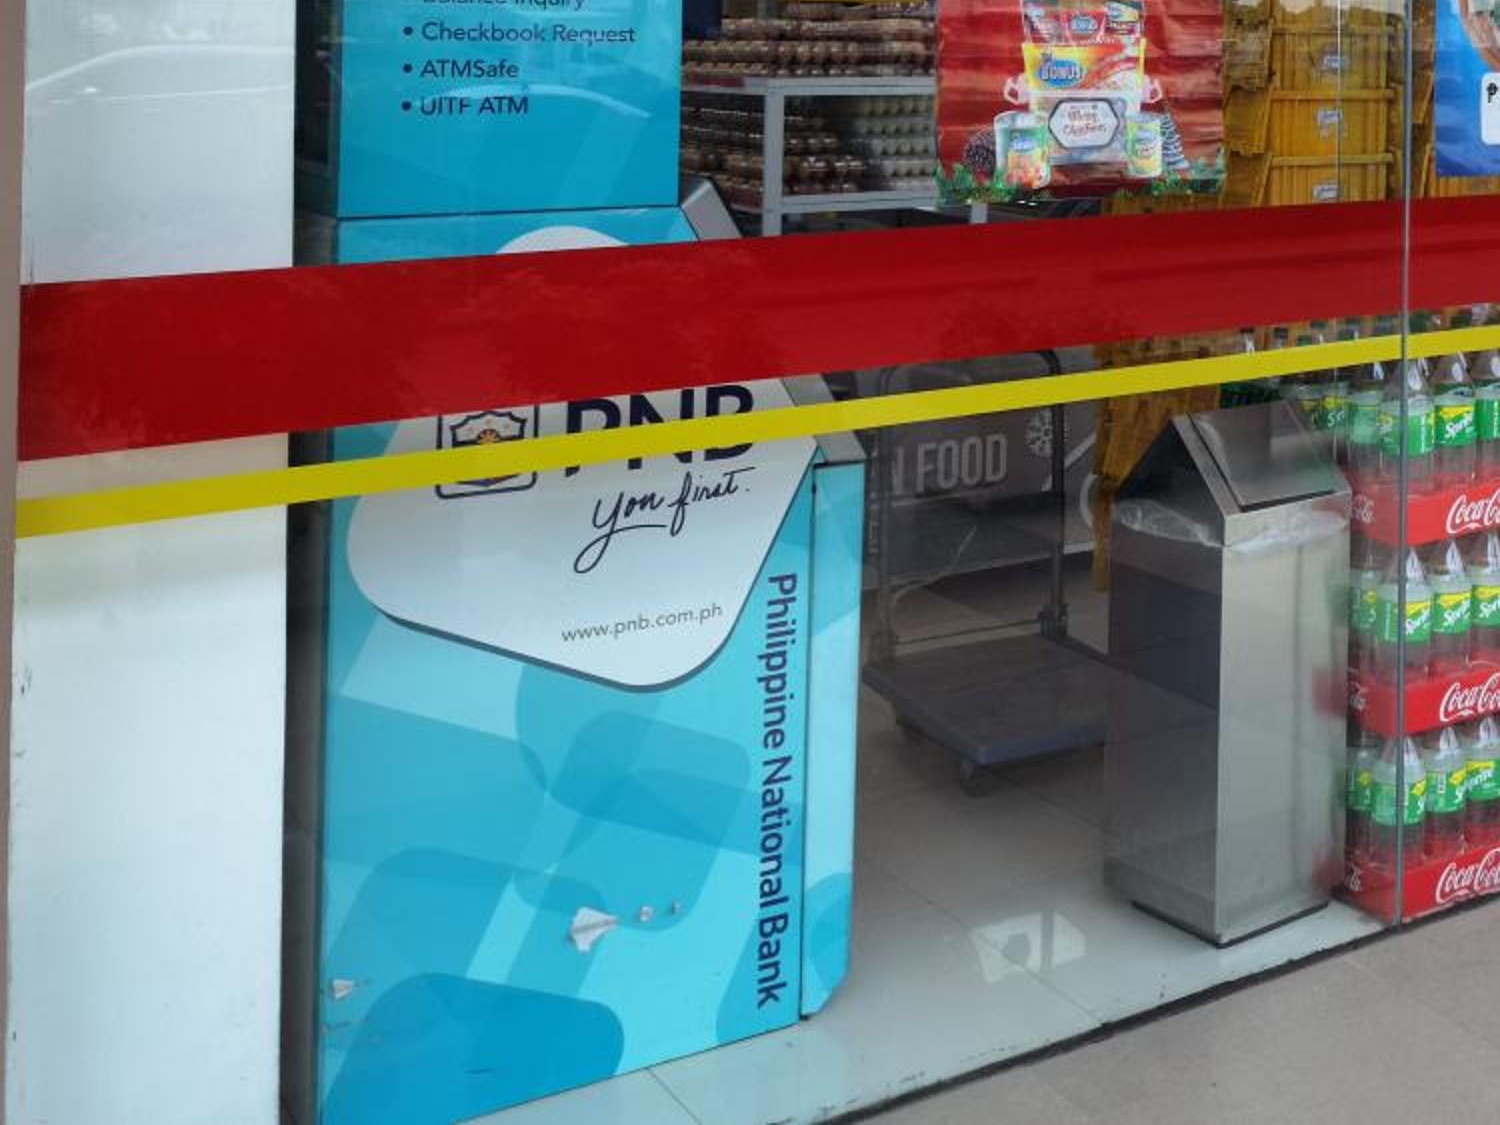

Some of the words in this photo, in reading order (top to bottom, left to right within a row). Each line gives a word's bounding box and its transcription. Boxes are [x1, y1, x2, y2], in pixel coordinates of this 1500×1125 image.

[420, 59, 519, 79] ATMSafe
[421, 21, 545, 43] Checkbook
[552, 24, 636, 48] Request
[420, 97, 471, 116] UITF
[478, 95, 529, 116] ATM
[565, 384, 754, 478] PNB
[916, 432, 1008, 492] FOOD
[574, 489, 666, 574] You
[561, 602, 723, 642] www.pnb.com.ph
[758, 572, 798, 750] Philippine
[759, 754, 794, 904] National
[758, 908, 789, 1011] Bank
